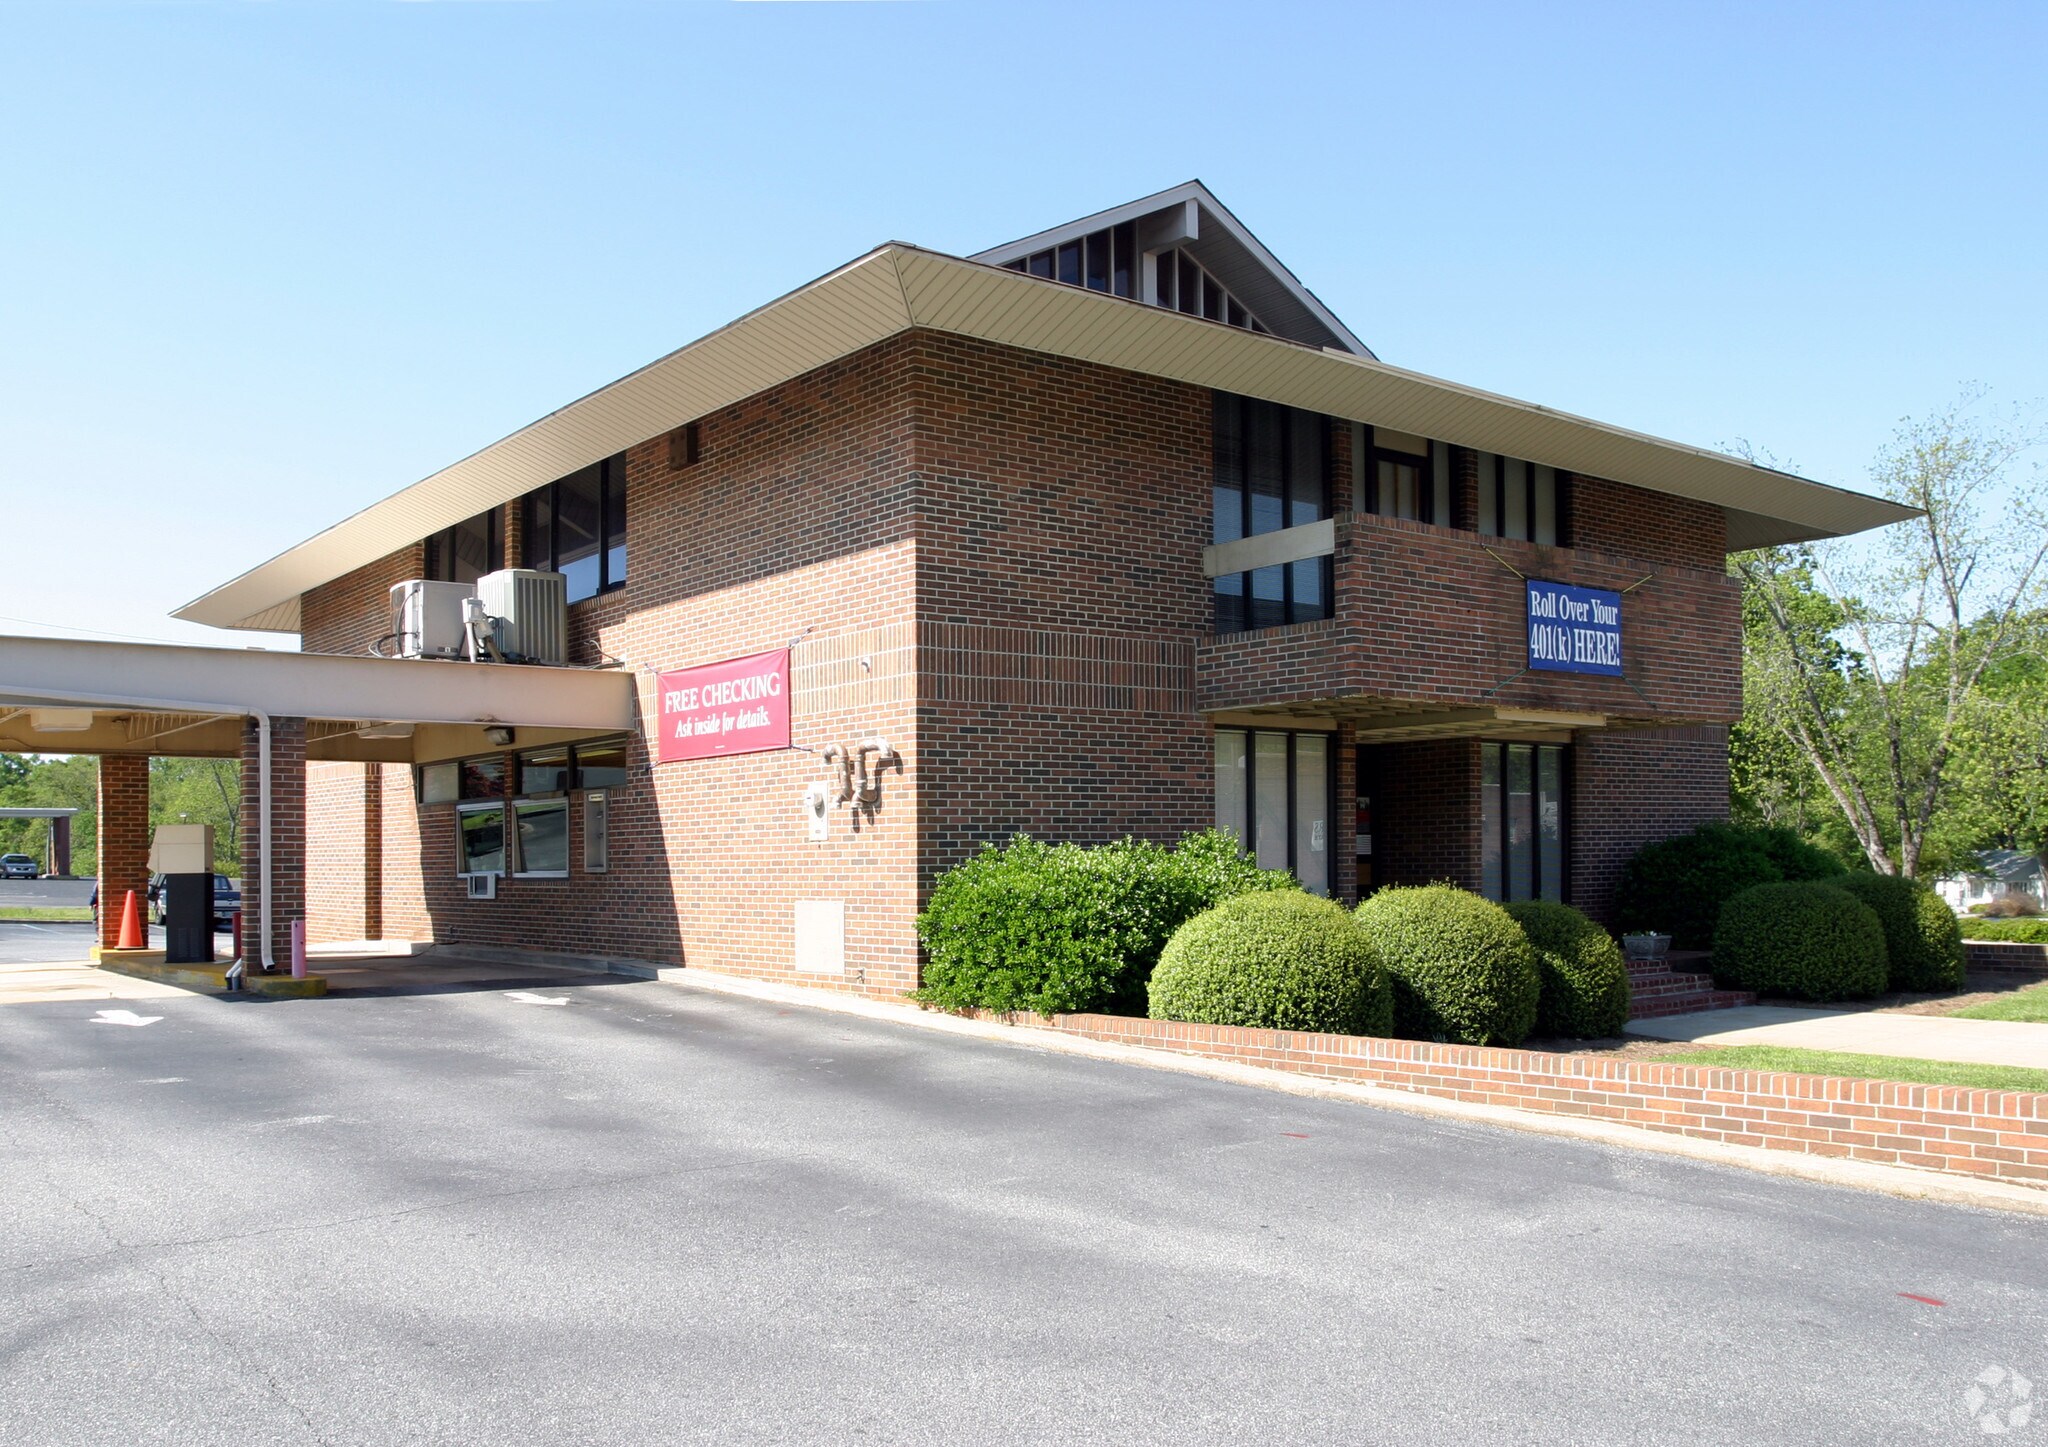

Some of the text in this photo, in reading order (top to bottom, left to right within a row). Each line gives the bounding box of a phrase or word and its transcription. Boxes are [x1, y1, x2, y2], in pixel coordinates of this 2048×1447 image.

[1530, 591, 1618, 625] Roll Over Your
[1530, 623, 1620, 666] 401(k) HERE!
[665, 672, 781, 714] FREE CHECKING
[675, 705, 771, 738] Ask inside for details.
